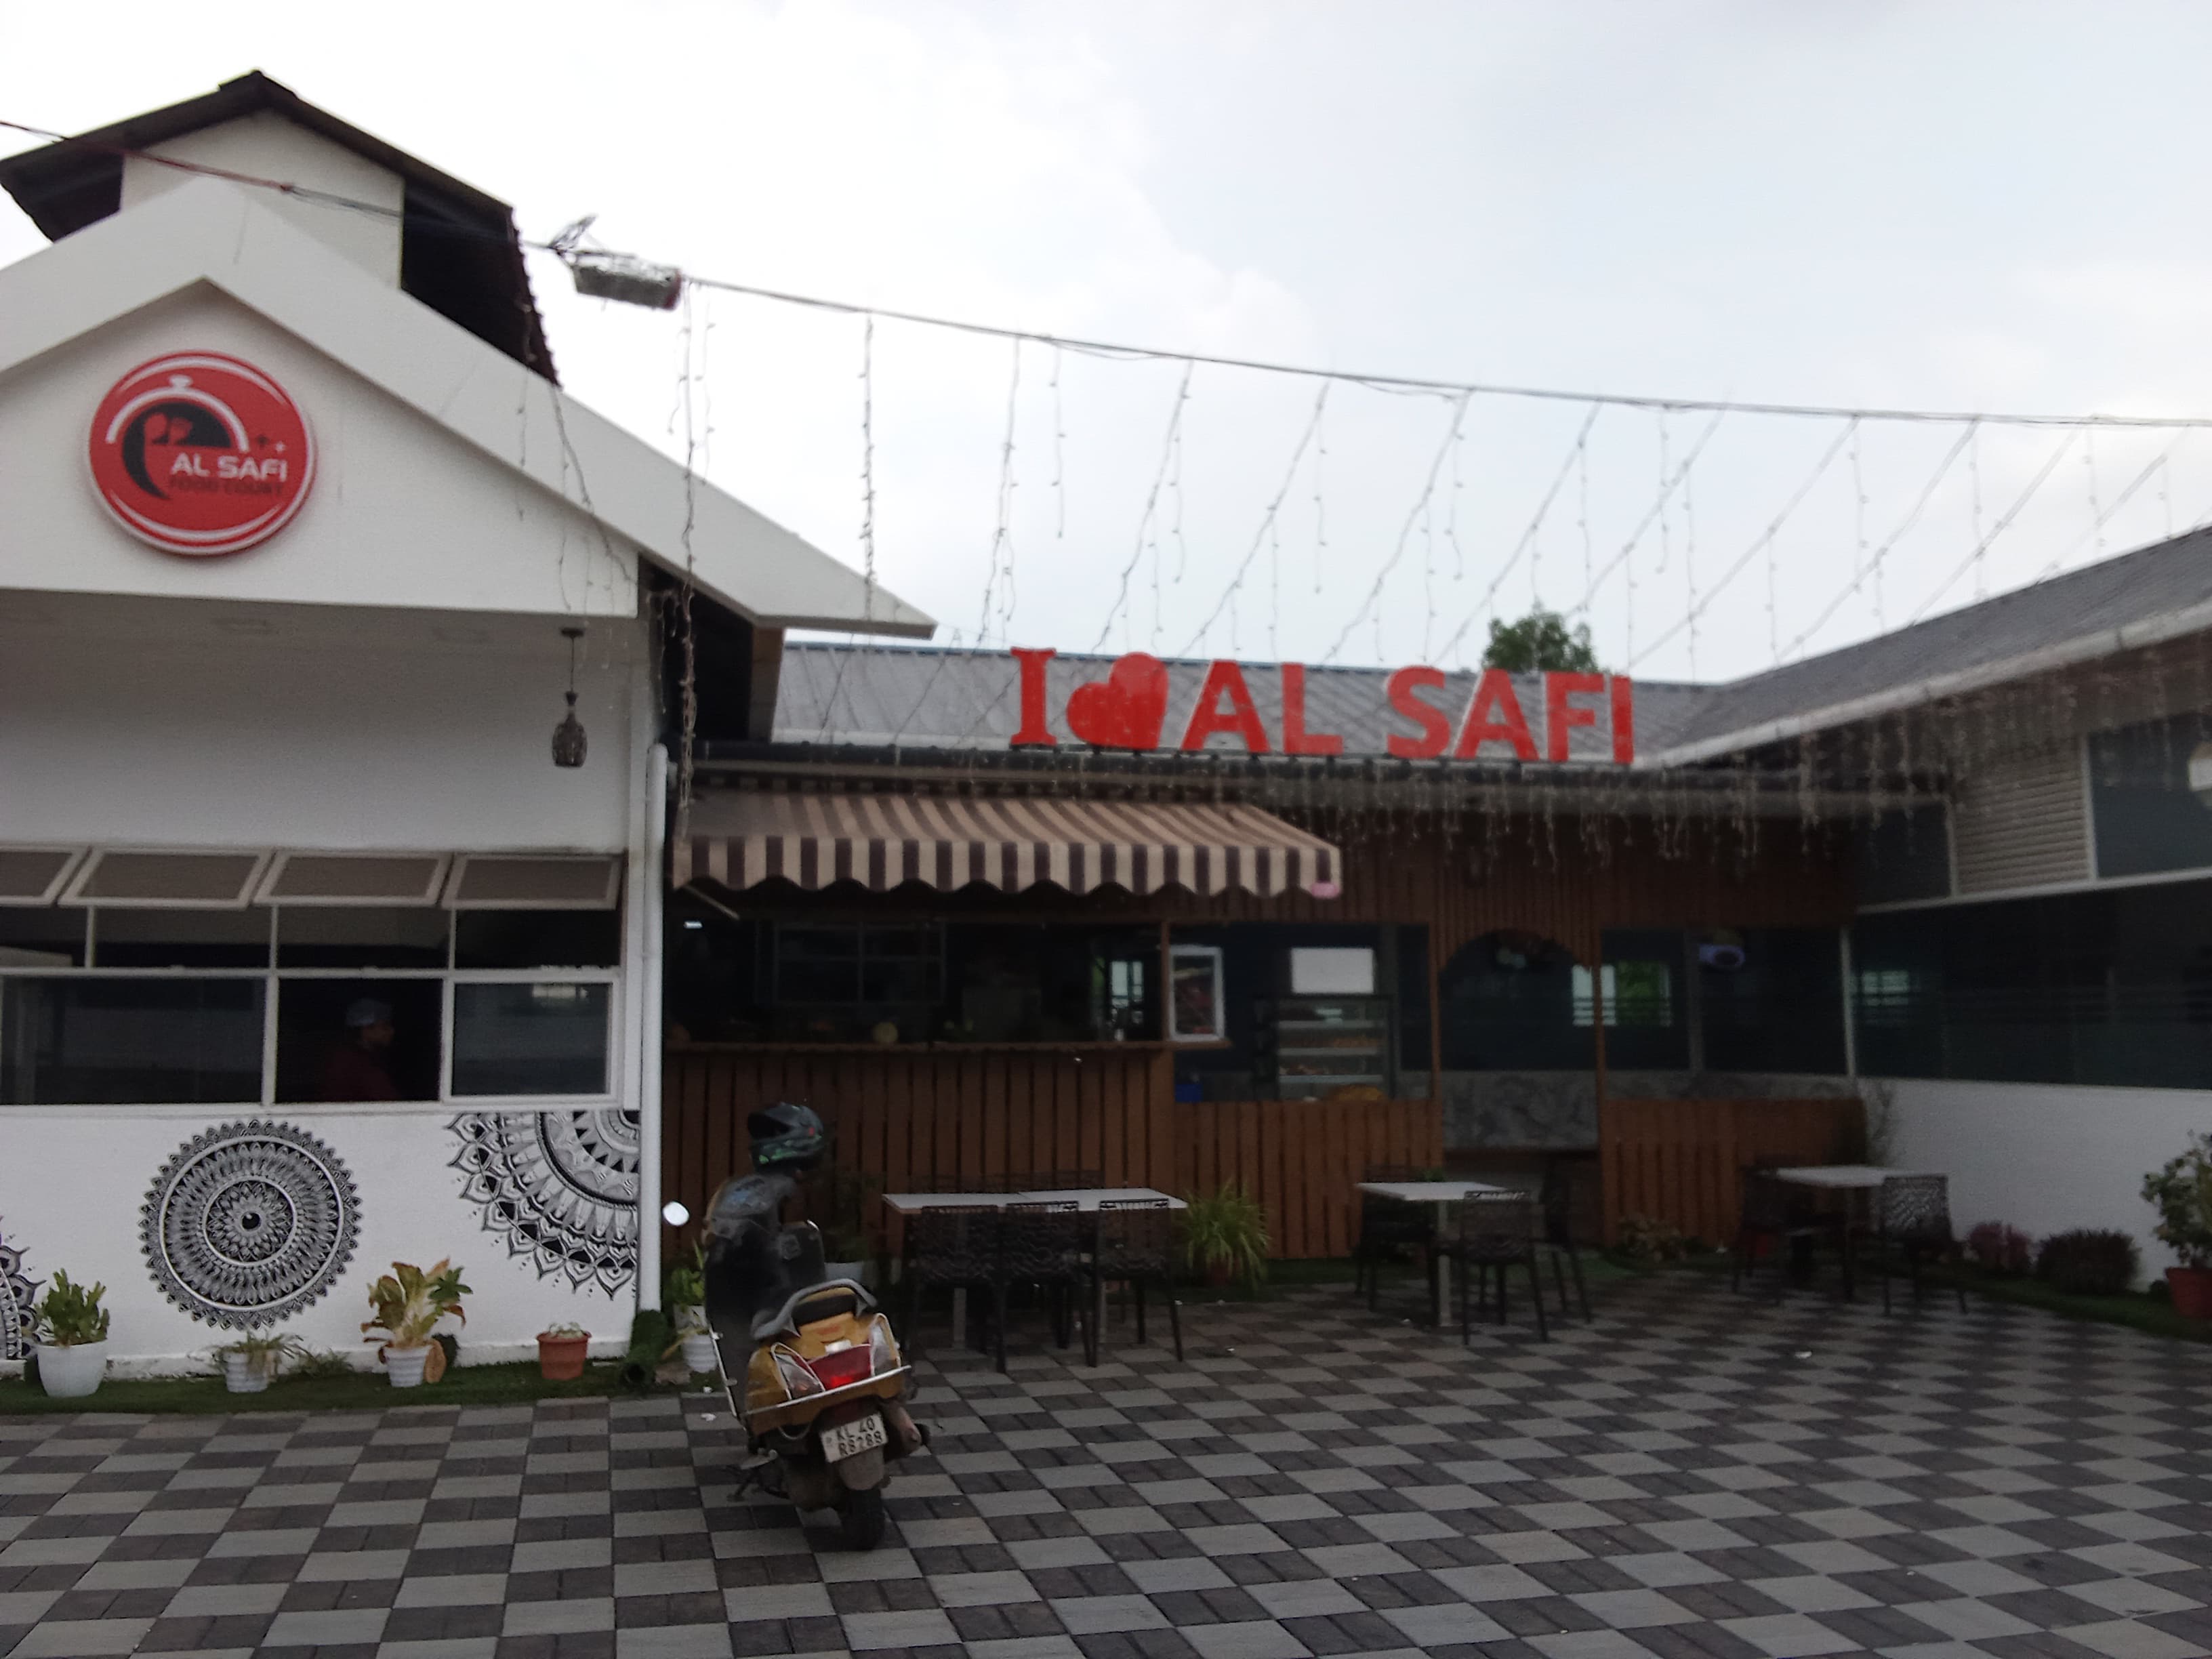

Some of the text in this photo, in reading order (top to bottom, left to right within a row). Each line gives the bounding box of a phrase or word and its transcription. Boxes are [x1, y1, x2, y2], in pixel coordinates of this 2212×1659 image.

[171, 453, 210, 477] AL
[1010, 647, 1635, 764] I AL SAFI
